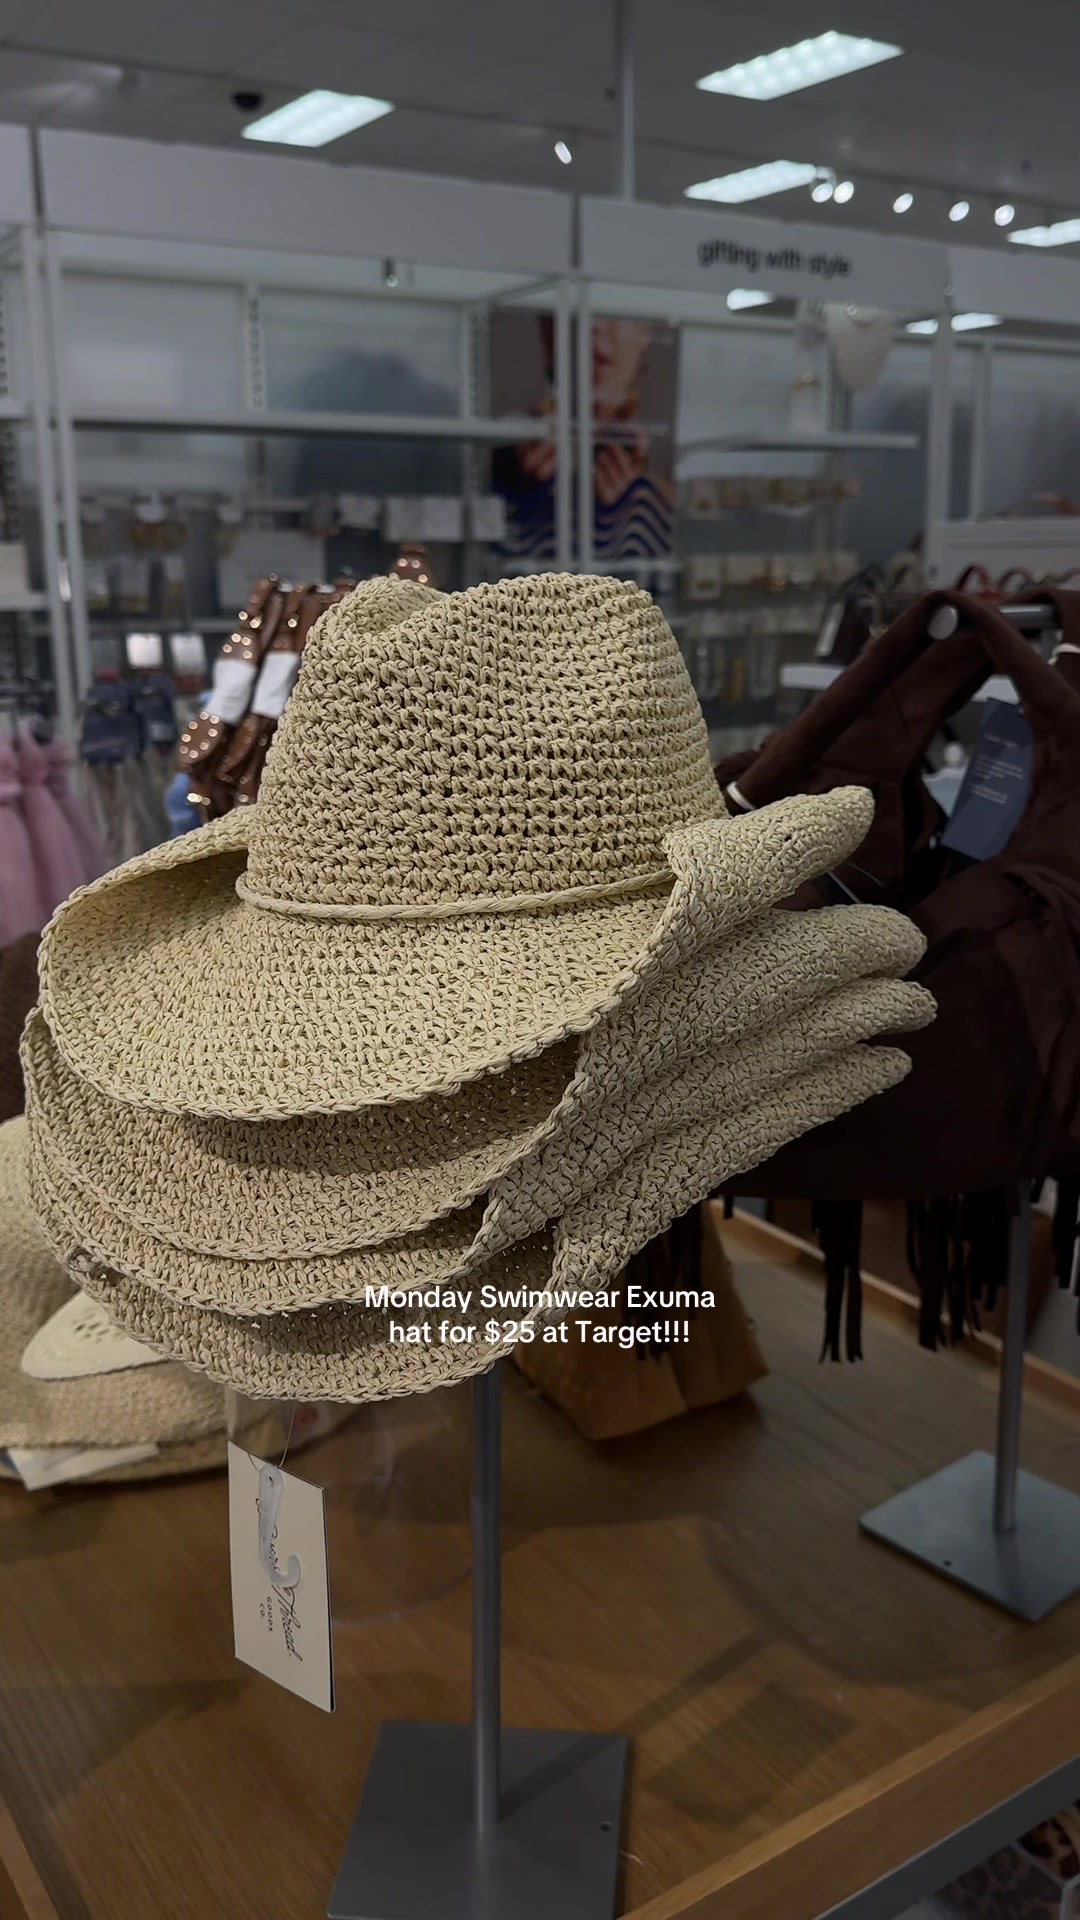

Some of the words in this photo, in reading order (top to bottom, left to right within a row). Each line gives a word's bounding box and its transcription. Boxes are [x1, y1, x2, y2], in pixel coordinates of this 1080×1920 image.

[698, 239, 760, 272] gifting
[766, 248, 801, 270] with
[808, 254, 851, 279] style
